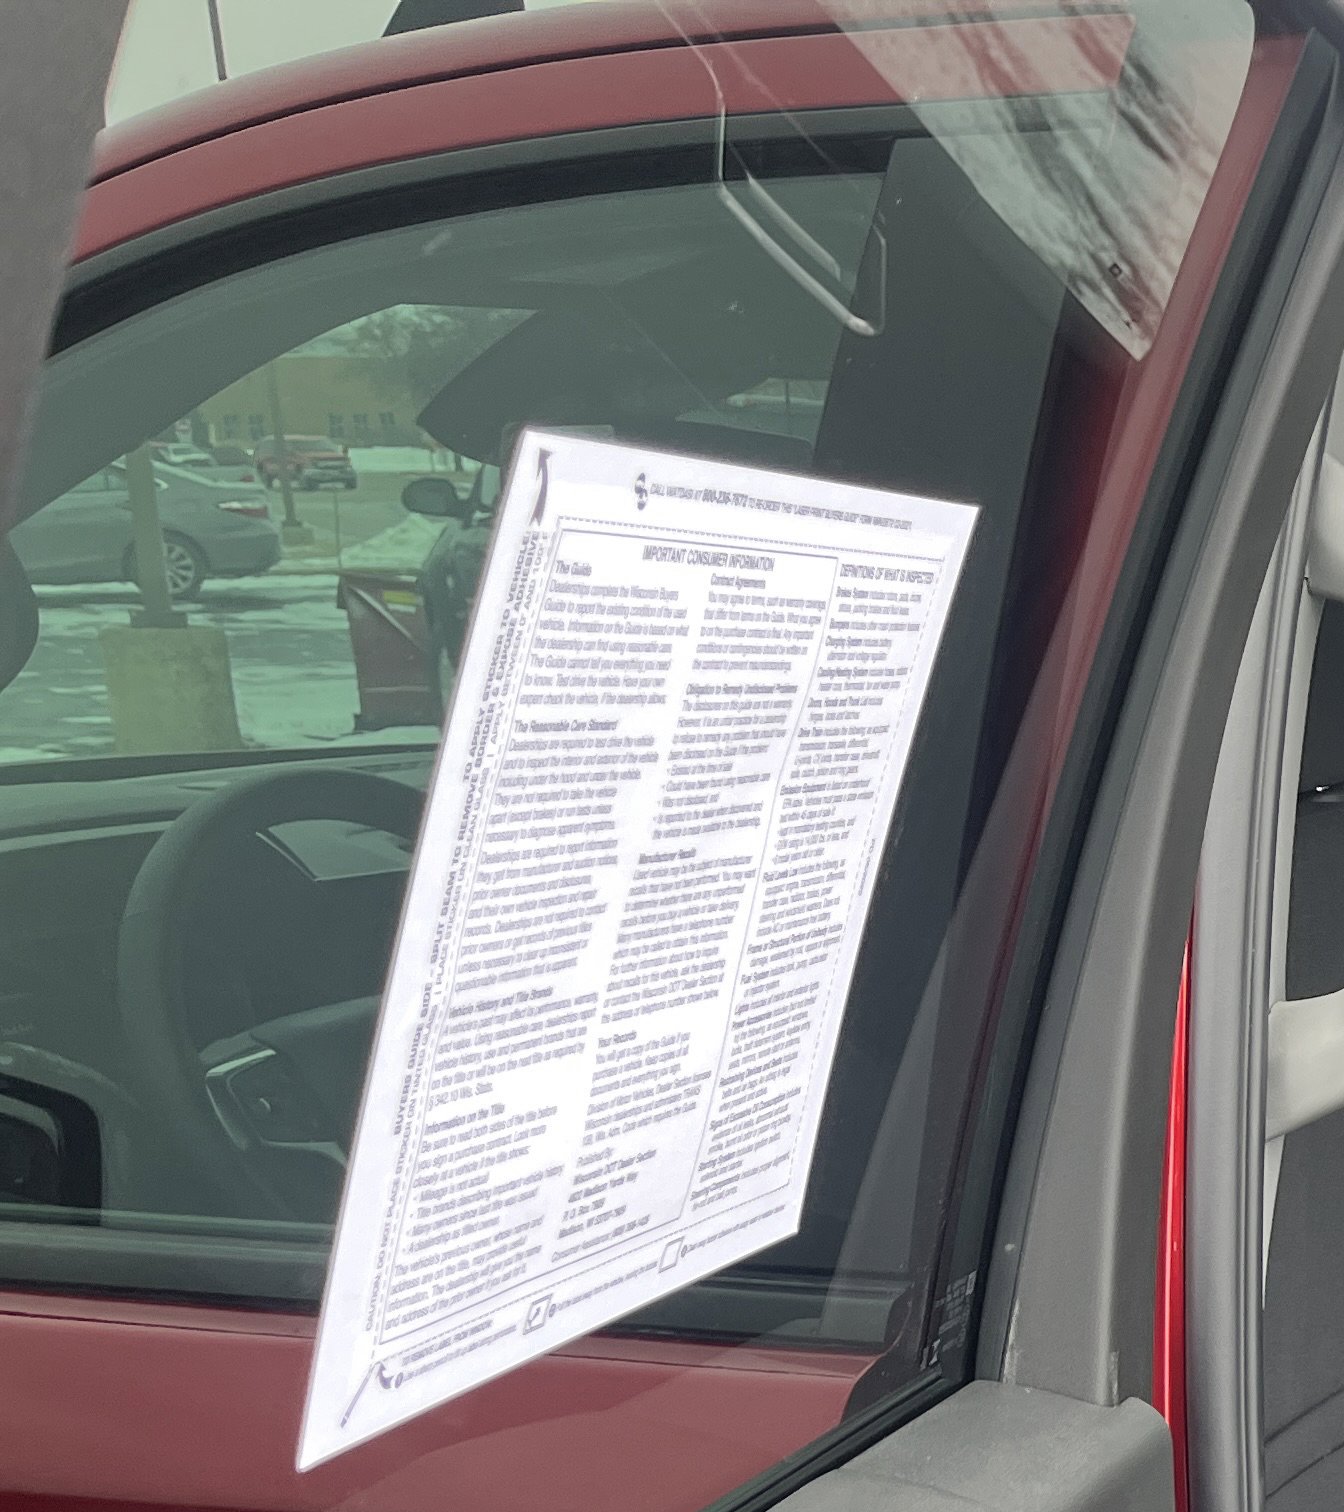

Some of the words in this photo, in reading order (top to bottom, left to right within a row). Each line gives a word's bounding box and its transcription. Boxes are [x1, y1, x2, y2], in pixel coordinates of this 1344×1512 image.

[569, 561, 593, 576] Guide
[641, 545, 686, 563] IMPORTANT
[685, 549, 728, 567] CONSUMER
[727, 553, 775, 571] INFORMATION
[468, 708, 485, 757] APPLY
[480, 634, 504, 701] STICKER
[489, 701, 505, 744] APPLY
[529, 719, 570, 732] Reasonable
[570, 718, 588, 731] Care
[587, 718, 619, 730] Standard
[473, 767, 489, 809] GLASS
[392, 1073, 413, 1135] BUYERS
[406, 1022, 424, 1069] GUIDE
[417, 981, 434, 1018] SIDE
[428, 920, 446, 964] SPLIT
[440, 870, 456, 916] SEAM
[457, 773, 478, 840] REMOVE
[473, 702, 495, 767] BORDER
[512, 531, 539, 611] ADHESIVE
[462, 814, 478, 857] CLEAN
[433, 942, 451, 985] PLACE
[420, 1004, 438, 1046] GLASS
[410, 1048, 427, 1095] TINTED
[393, 1120, 413, 1175] STICKER
[385, 1176, 401, 1218] PLACE
[380, 1221, 392, 1248] NOT
